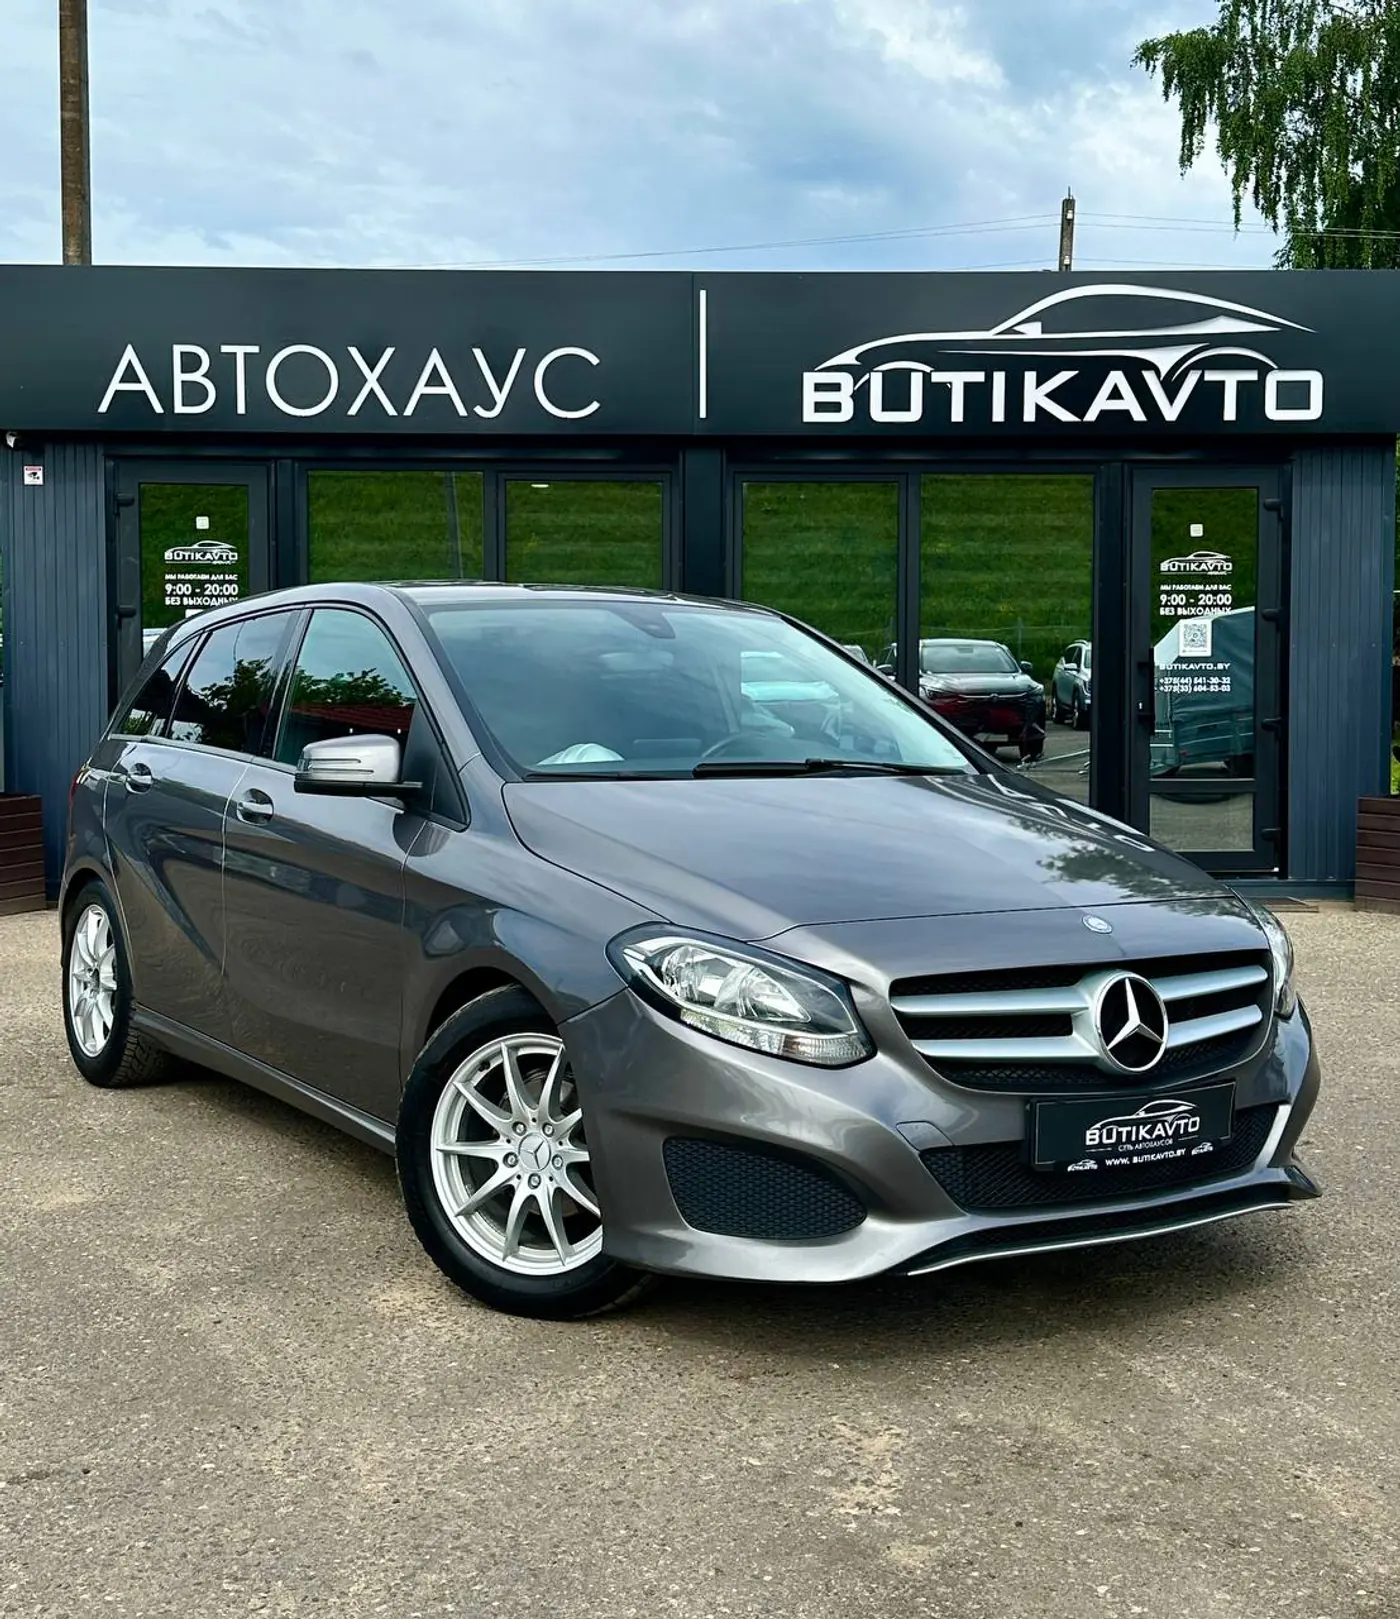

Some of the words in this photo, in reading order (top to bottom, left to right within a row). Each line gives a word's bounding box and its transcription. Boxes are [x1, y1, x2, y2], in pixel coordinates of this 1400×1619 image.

[98, 343, 601, 419] АВТОХАУС
[802, 370, 1324, 423] BUTIKAVTO
[164, 551, 238, 561] BUTIKAVTO
[1160, 561, 1233, 572] BUTIKAVTO
[164, 583, 192, 595] 9:00
[203, 583, 239, 596] 20:00
[164, 596, 181, 606] БЕЗ
[1160, 593, 1186, 606] 9:00
[1197, 593, 1232, 606] 20:00
[1159, 606, 1176, 616] БЕЗ
[1177, 606, 1232, 617] ВЫХОДНЫХ
[1085, 1116, 1201, 1146] BUTIKAVTO
